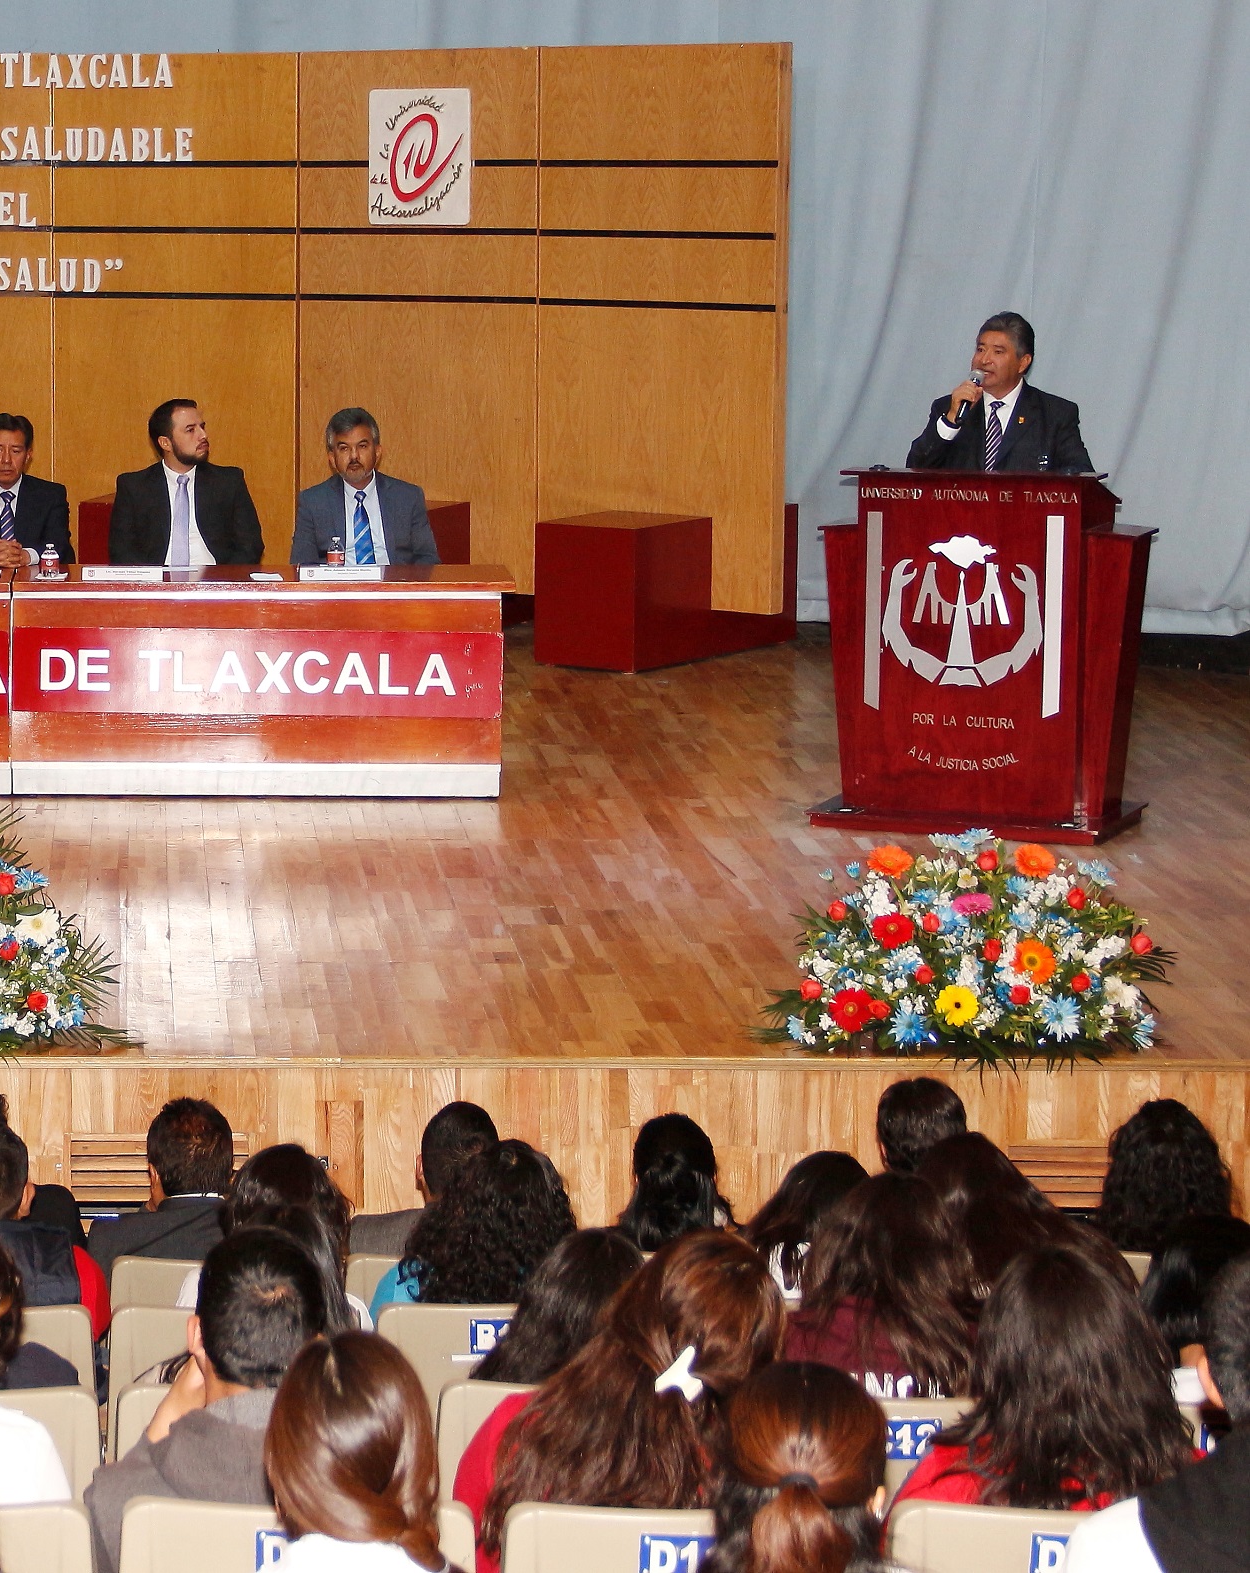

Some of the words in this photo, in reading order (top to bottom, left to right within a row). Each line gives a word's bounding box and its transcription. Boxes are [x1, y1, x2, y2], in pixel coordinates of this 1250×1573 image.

[0, 53, 174, 89] TLAXCALA
[385, 95, 445, 131] Universidad
[0, 127, 194, 163] SALUDABLE
[861, 487, 923, 500] UNIVERSIDAD
[931, 484, 990, 502] AUTÓNOMA
[999, 490, 1013, 503] DE
[1023, 491, 1079, 504] TLAXCALA
[39, 648, 110, 693] DE
[139, 650, 457, 697] TLAXCALA
[912, 713, 934, 725] POR
[943, 715, 957, 726] LA
[966, 715, 1015, 729] CULTURA
[907, 746, 916, 757] A
[917, 750, 931, 764] LA
[935, 756, 979, 771] JUSTICIA
[982, 753, 1020, 770] SOCIAL
